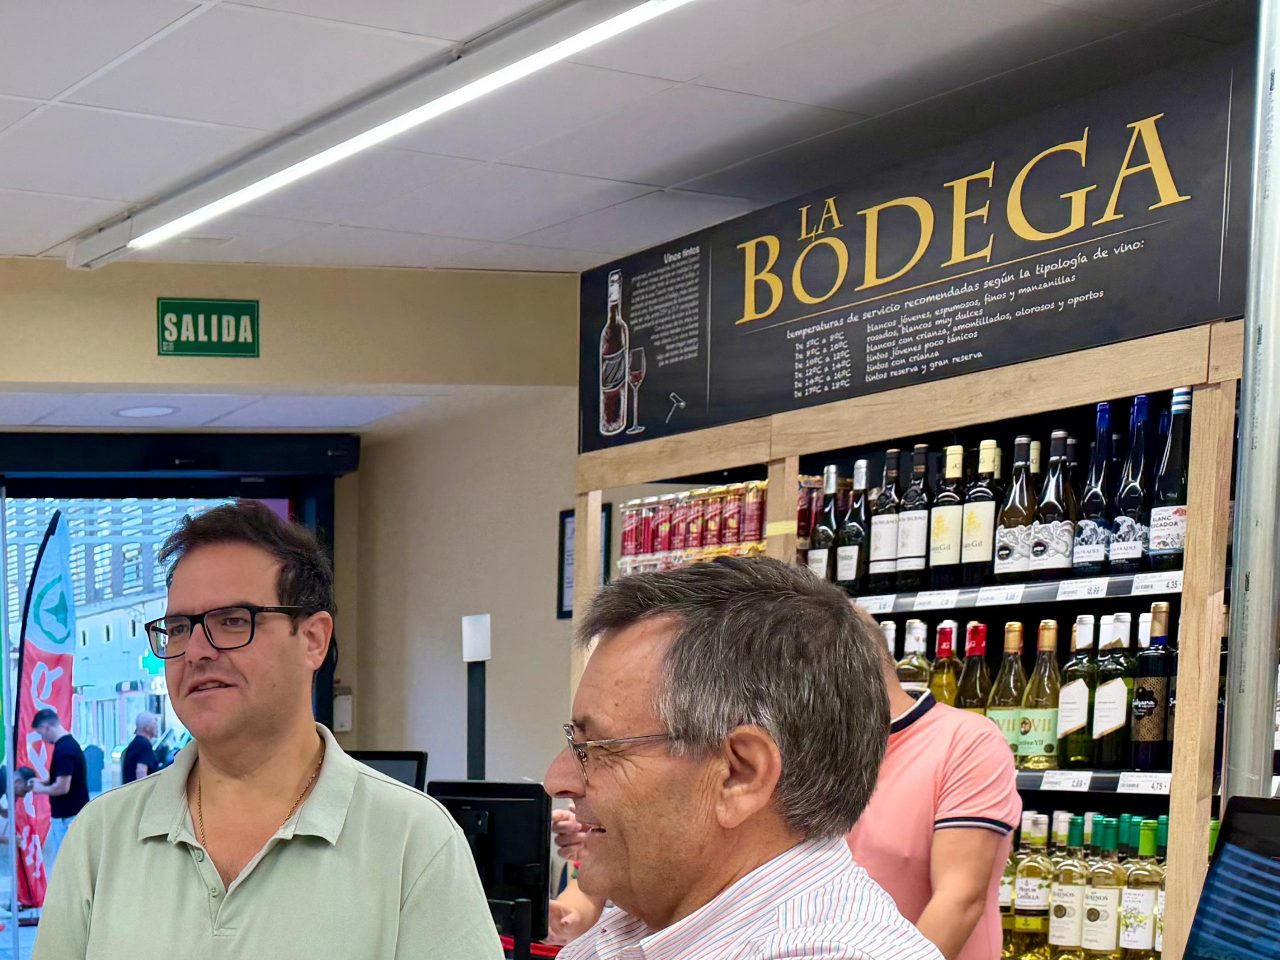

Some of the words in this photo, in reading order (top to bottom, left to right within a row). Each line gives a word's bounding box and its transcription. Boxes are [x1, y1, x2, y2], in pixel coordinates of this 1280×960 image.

[735, 113, 1192, 326] BODEGA
[798, 197, 844, 241] LA
[787, 318, 843, 339] temperaturas
[847, 313, 859, 323] de
[863, 302, 900, 319] servicio
[905, 283, 980, 309] recomendadas
[983, 272, 1015, 289] según
[1020, 268, 1030, 279] la
[1036, 253, 1088, 277] tipología
[1093, 248, 1108, 259] de
[1114, 240, 1145, 254] vino:
[867, 319, 896, 332] blancos
[899, 313, 932, 327] jóvenes,
[935, 300, 981, 316] espumosos,
[984, 293, 1007, 304] finos
[1018, 274, 1076, 295] manzanillas
[164, 313, 253, 343] SALIDA
[866, 340, 896, 353] blancos
[898, 336, 913, 345] con
[916, 328, 950, 341] crianza,
[953, 312, 1012, 332] amontillados,
[1015, 302, 1055, 317] olorosos
[1067, 290, 1104, 308] oportos
[867, 329, 899, 342] rosados,
[902, 321, 932, 334] blancos
[935, 318, 952, 328] muy
[955, 308, 983, 321] dulces
[866, 350, 888, 362] tintos
[890, 343, 921, 360] jóvenes
[924, 340, 944, 352] poco
[947, 331, 978, 344] tánicos
[866, 361, 889, 372] tintos
[891, 358, 906, 366] con
[909, 350, 940, 362] crianza
[865, 371, 888, 382] tintos
[890, 366, 919, 377] reserva
[929, 358, 949, 369] gran
[952, 352, 983, 364] reserva
